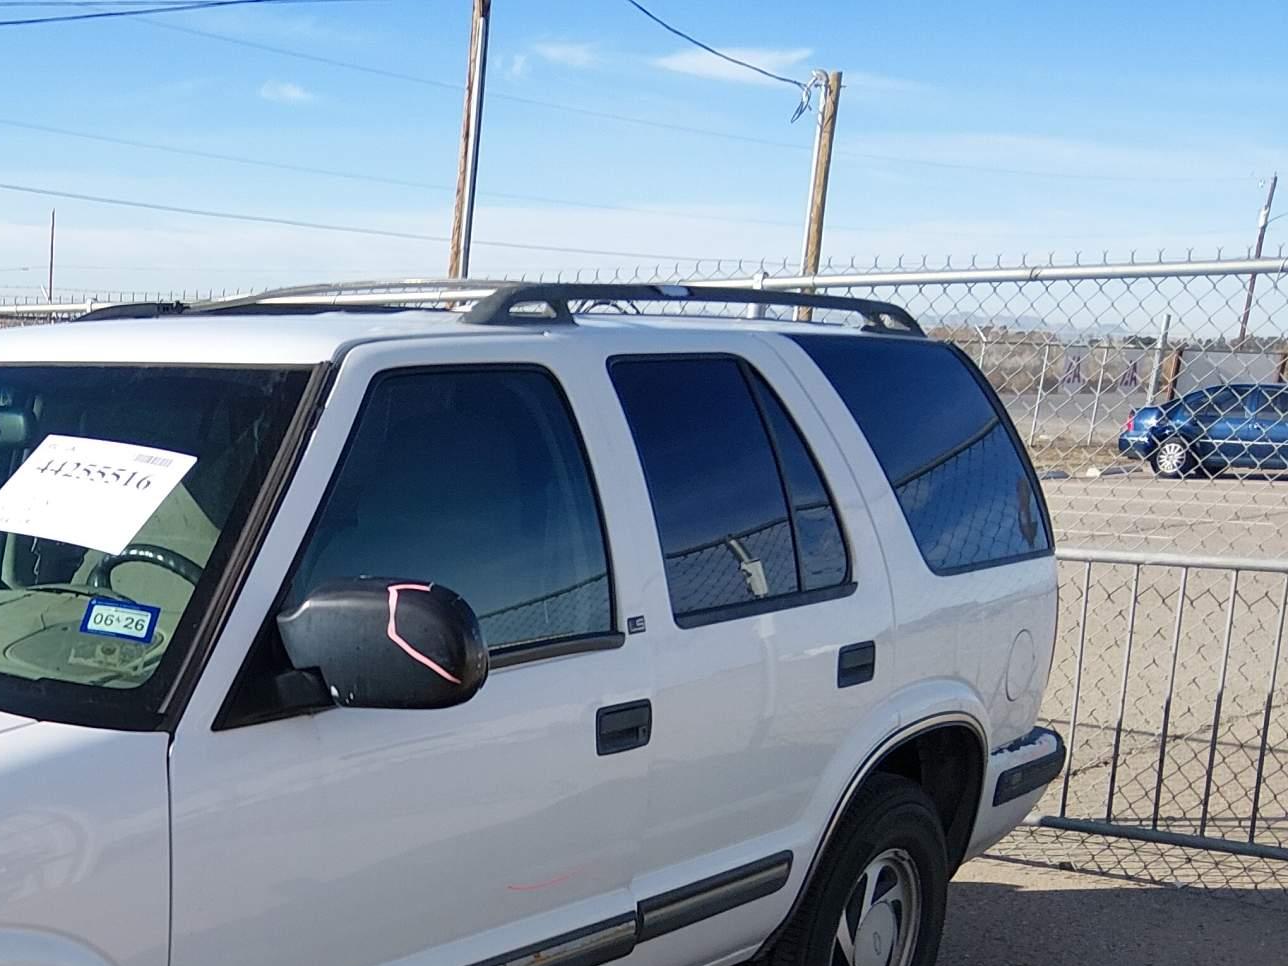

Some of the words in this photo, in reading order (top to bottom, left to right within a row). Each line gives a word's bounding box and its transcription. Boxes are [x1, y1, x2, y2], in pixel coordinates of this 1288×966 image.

[37, 459, 152, 490] 44255516
[93, 613, 115, 627] 06
[123, 617, 146, 631] 26
